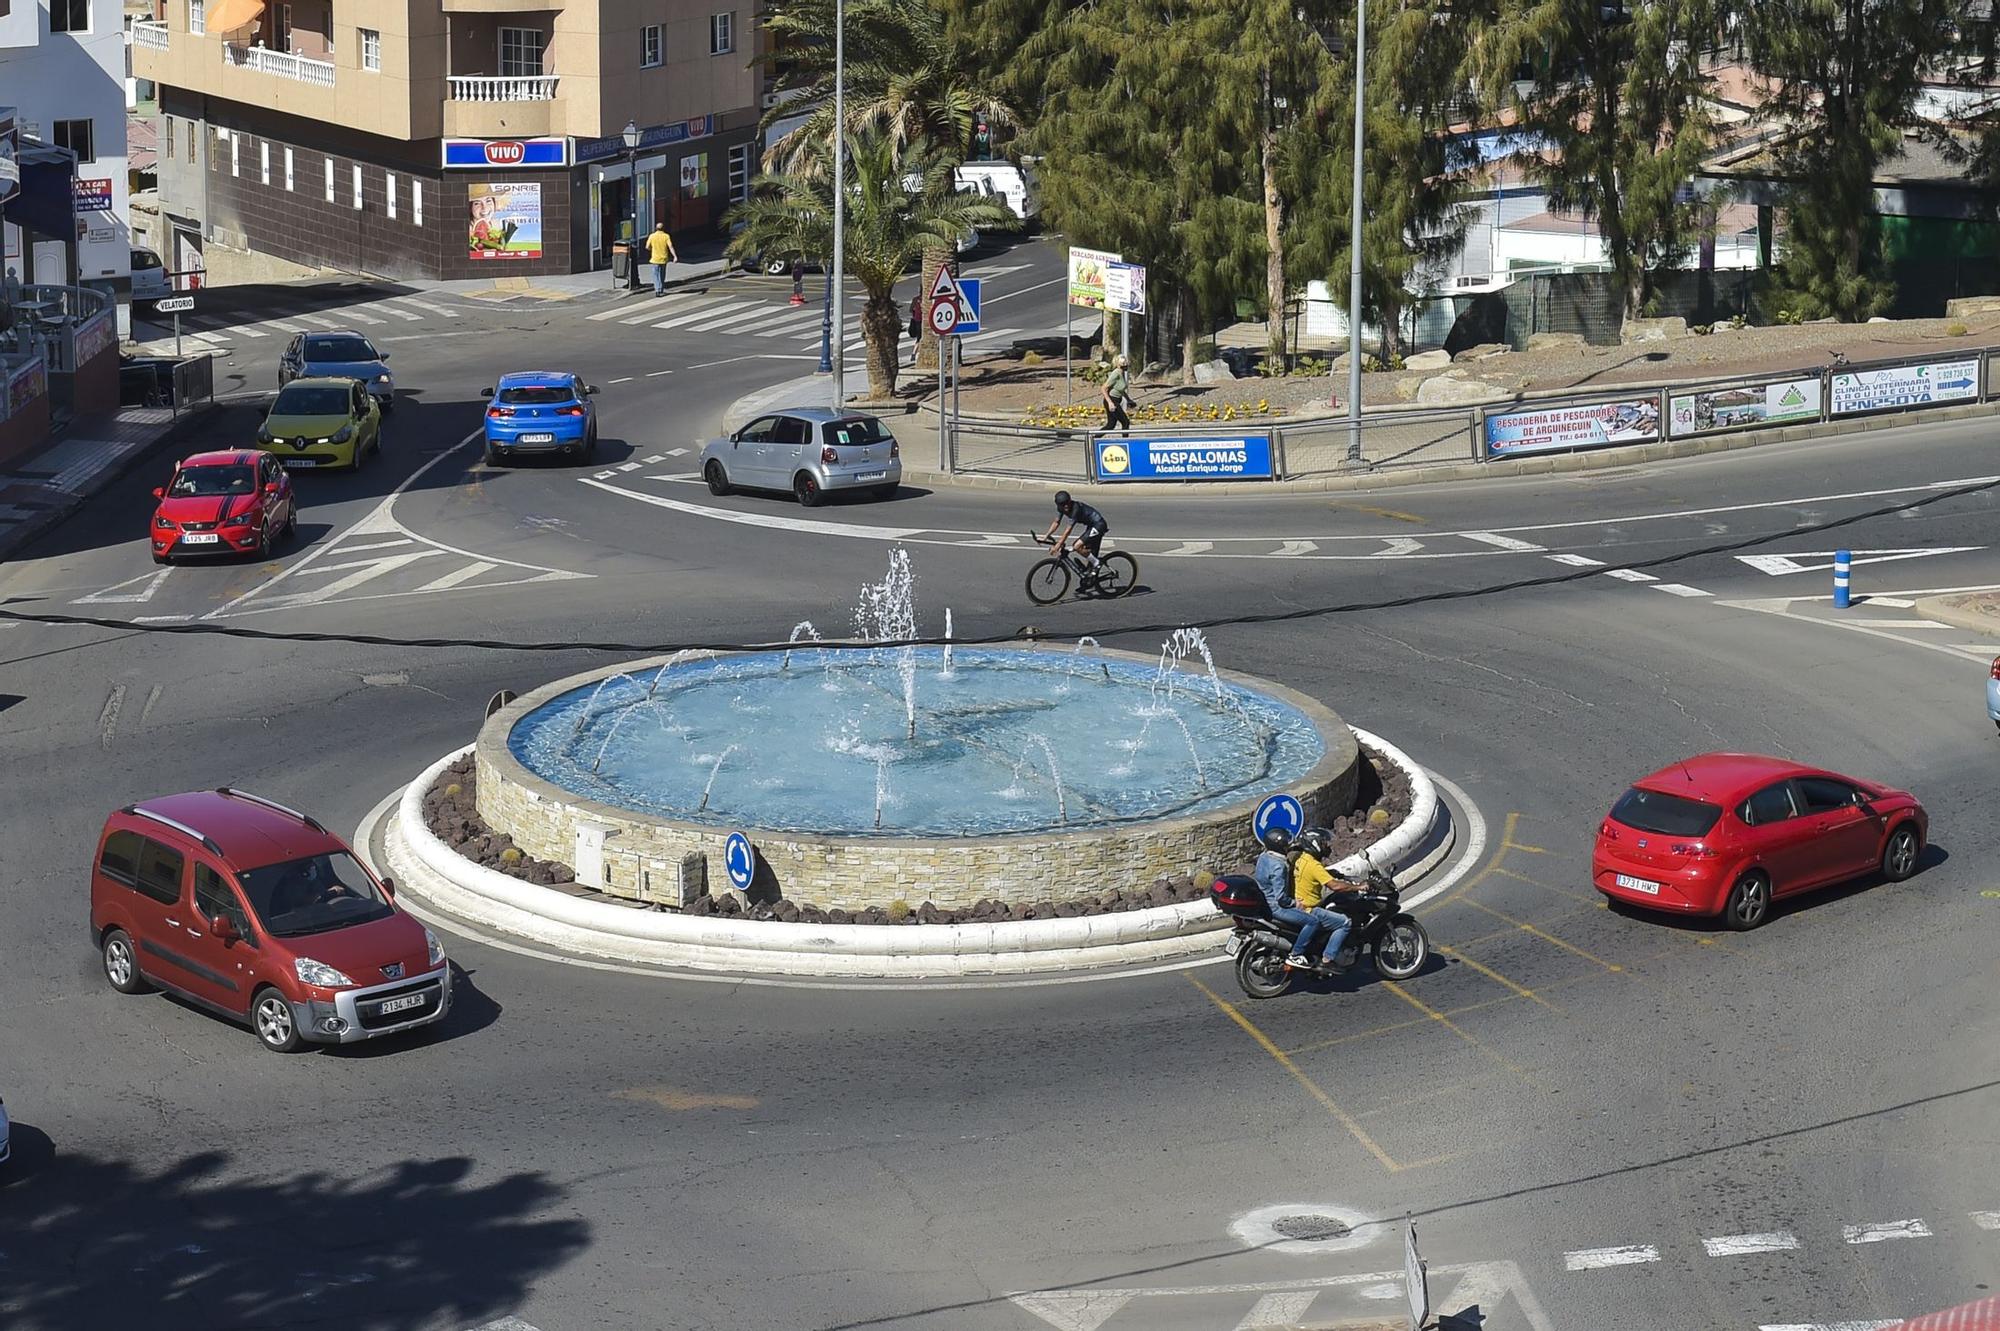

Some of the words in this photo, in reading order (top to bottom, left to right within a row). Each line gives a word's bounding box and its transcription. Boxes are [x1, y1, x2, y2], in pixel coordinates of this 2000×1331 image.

[582, 138, 627, 156] SUPERMERCA
[160, 299, 193, 310] VELATORIO
[936, 311, 953, 323] 20
[1873, 378, 1931, 390] VETERINARIA
[1551, 413, 1561, 422] DE
[1564, 407, 1617, 420] PESCADORES
[1523, 428, 1534, 437] DE
[1536, 421, 1592, 435] ARGUINEGUIN
[1149, 451, 1247, 465] MASPALOMAS
[1156, 465, 1185, 473] Alcalde
[1186, 464, 1218, 474] Enrique
[1219, 464, 1243, 473] Jorge
[1621, 876, 1640, 888] 3731
[383, 1000, 403, 1013] 2134
[406, 995, 422, 1007] HJR
